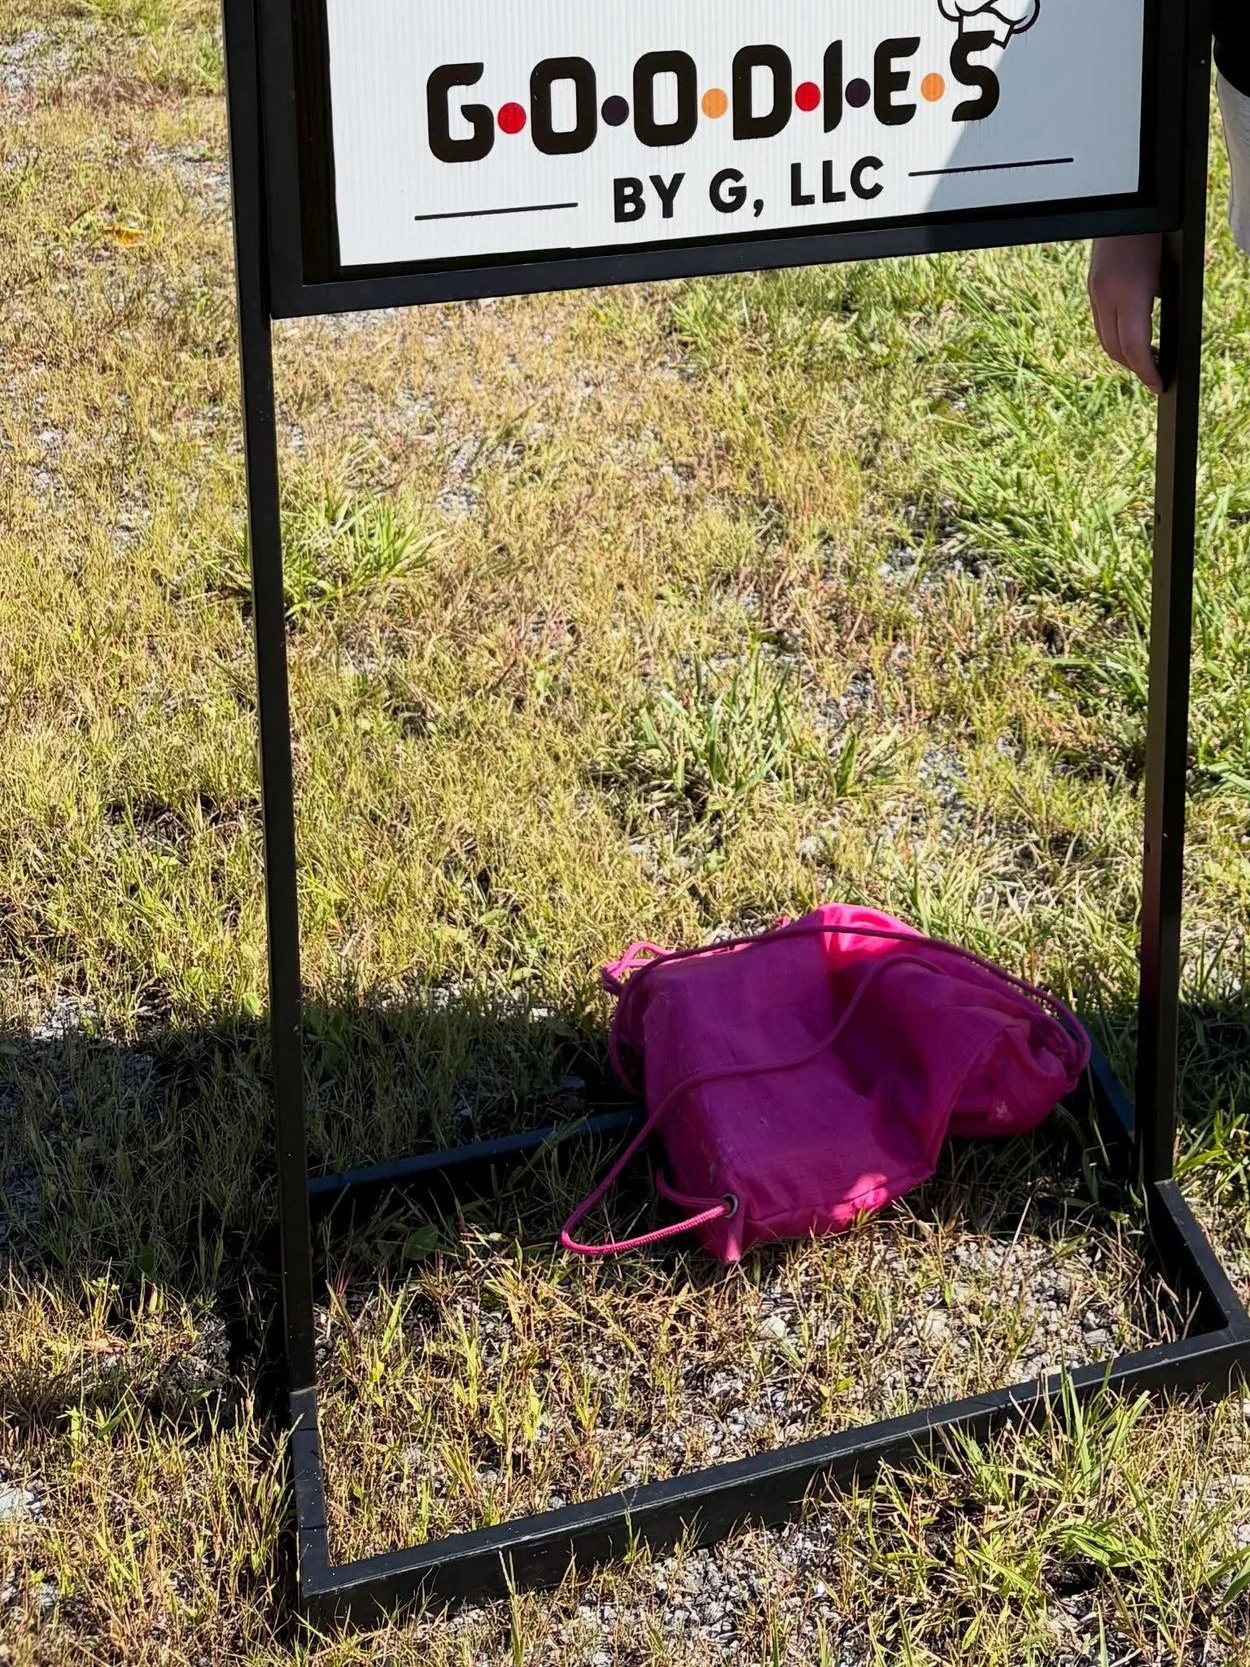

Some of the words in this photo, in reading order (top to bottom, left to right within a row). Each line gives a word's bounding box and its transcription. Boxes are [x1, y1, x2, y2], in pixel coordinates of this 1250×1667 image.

[613, 172, 686, 223] BY
[709, 167, 765, 217] G,
[790, 156, 885, 206] LLC
